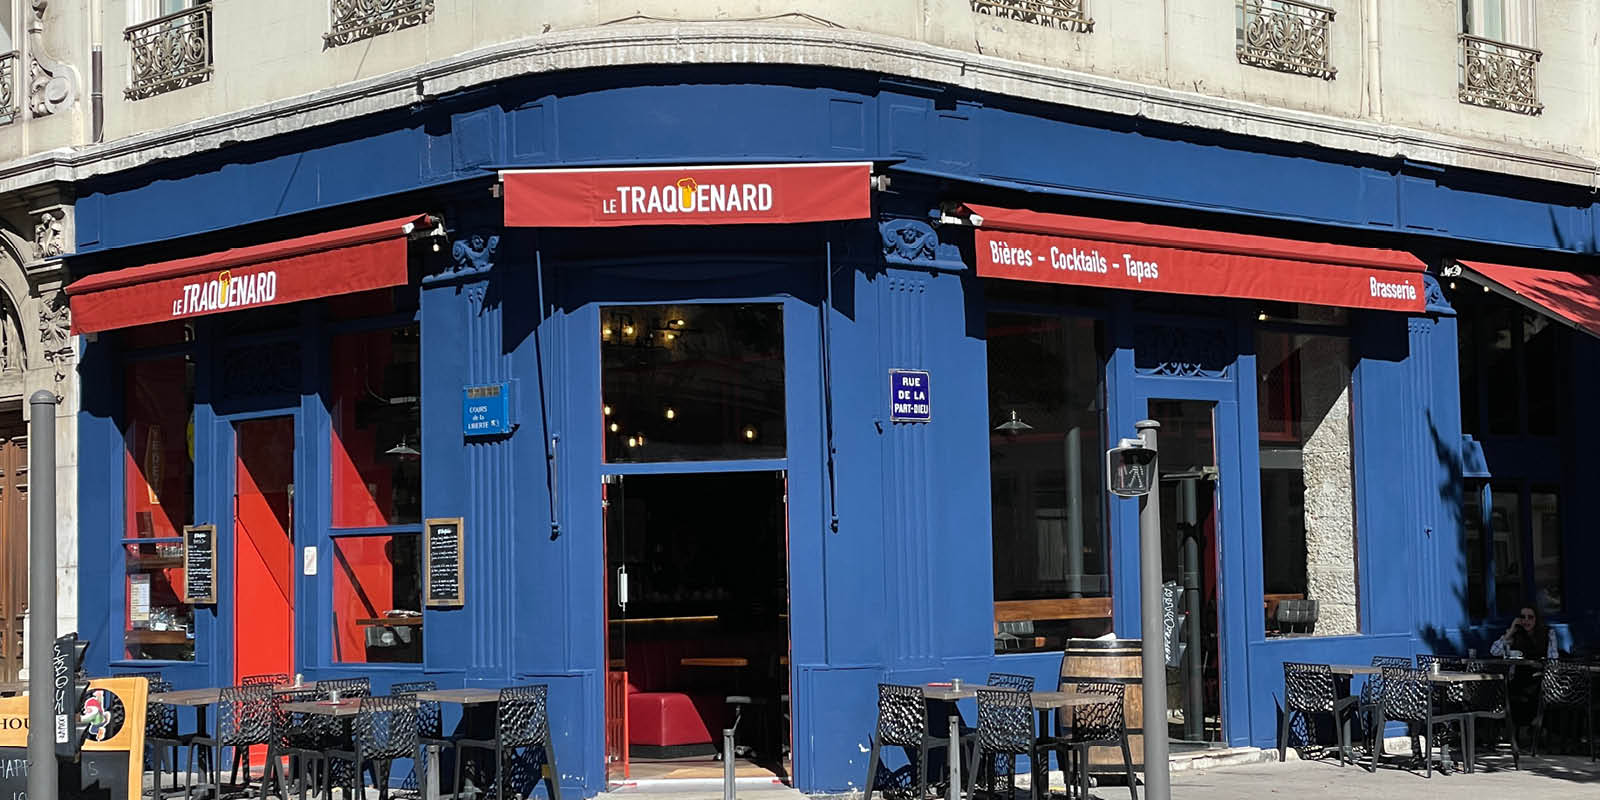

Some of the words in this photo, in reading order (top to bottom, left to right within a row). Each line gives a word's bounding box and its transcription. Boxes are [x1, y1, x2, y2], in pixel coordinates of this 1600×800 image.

[603, 199, 616, 214] LE
[616, 183, 773, 214] TRAQUENARD
[989, 240, 1032, 267] Bières
[1050, 246, 1107, 273] Cocktails
[1122, 253, 1158, 283] Tapas
[172, 299, 183, 316] LE
[183, 270, 276, 314] TRAQUENARD
[1370, 276, 1416, 300] Brasserie
[902, 377, 921, 387] RUE
[898, 390, 910, 399] DE
[914, 391, 925, 401] LA
[469, 405, 488, 413] COURS
[894, 403, 929, 414] PART-DIEU
